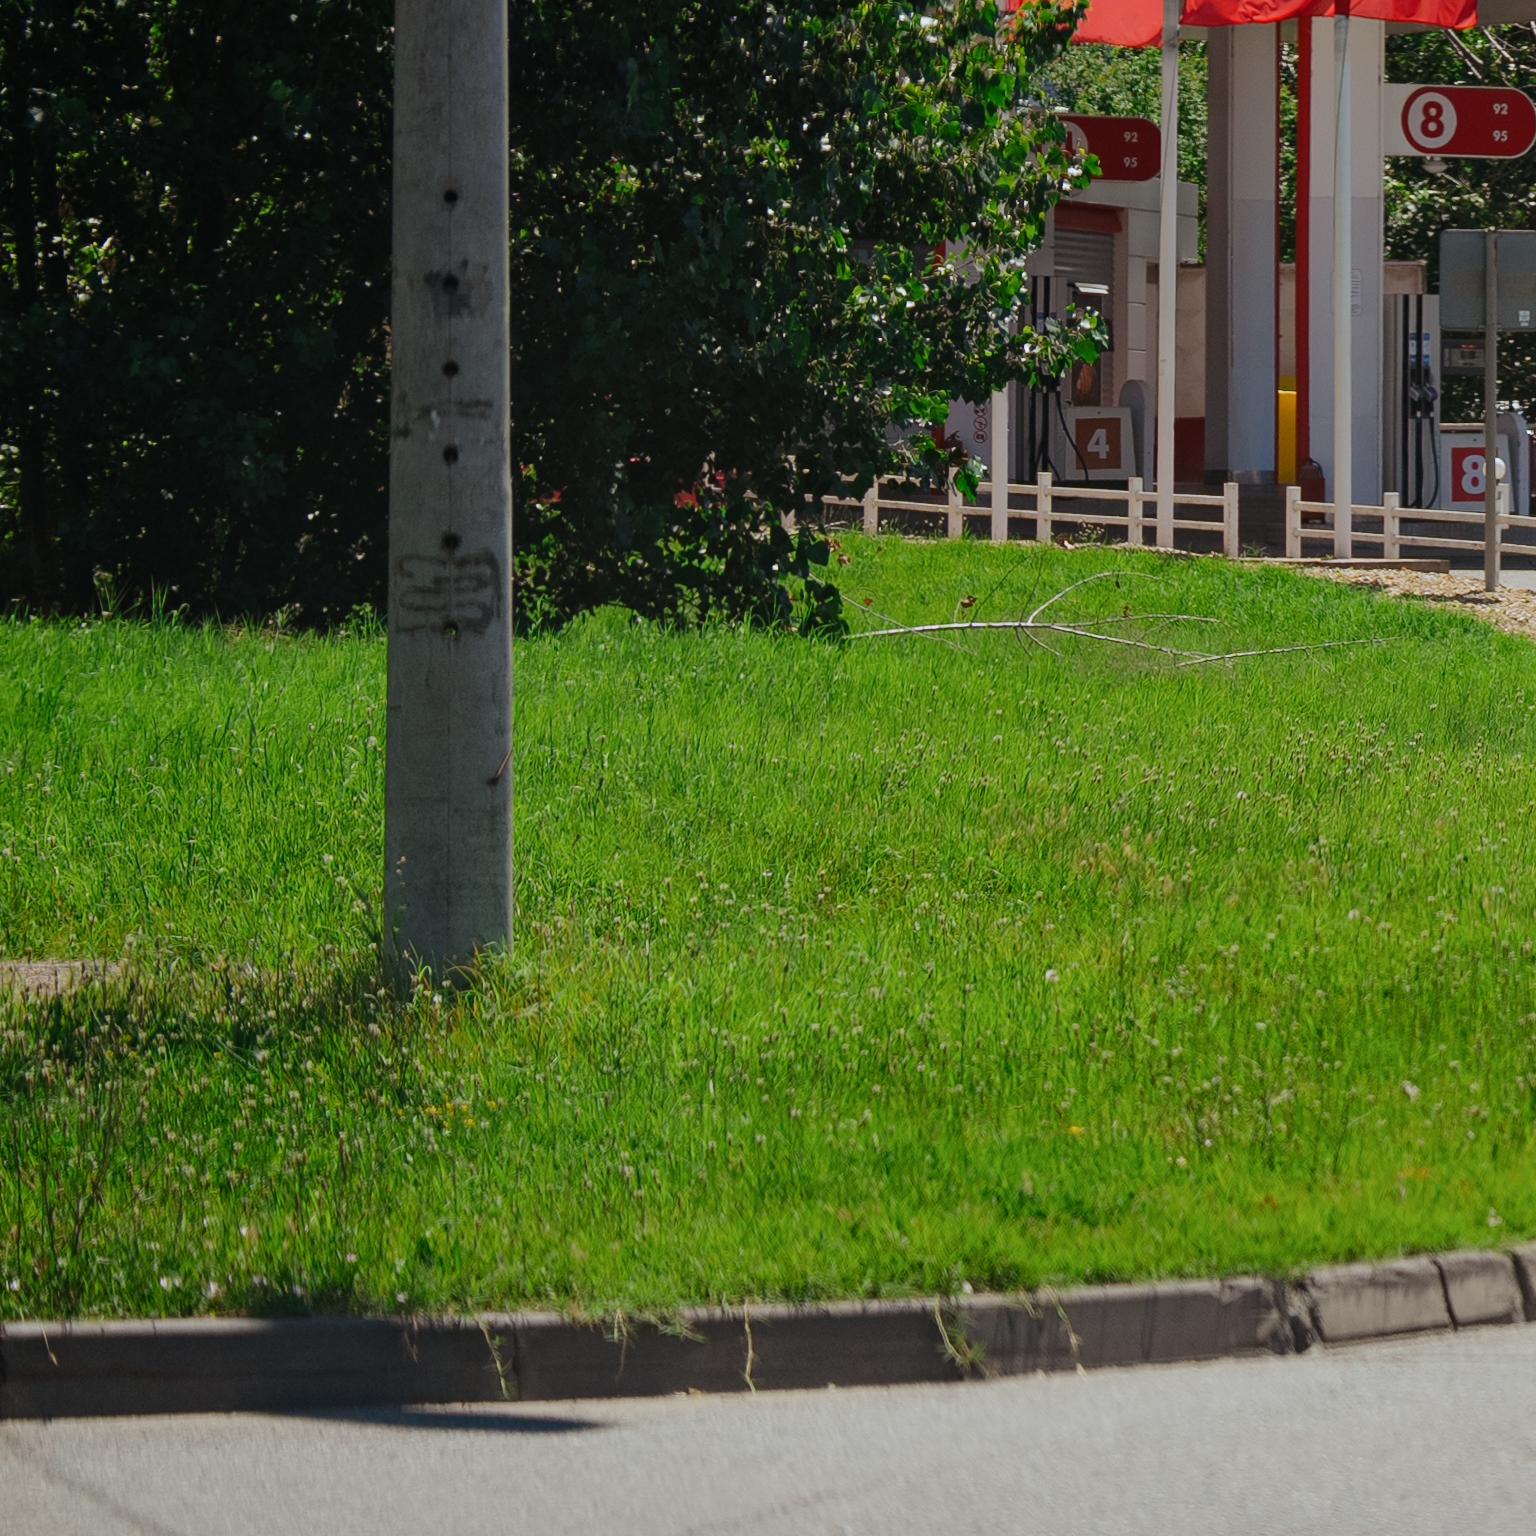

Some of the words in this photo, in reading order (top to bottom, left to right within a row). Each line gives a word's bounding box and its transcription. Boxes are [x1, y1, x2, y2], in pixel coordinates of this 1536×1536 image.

[1493, 103, 1508, 115] 92
[1421, 101, 1445, 138] 8
[1123, 131, 1138, 143] 92
[1493, 130, 1508, 142] 95
[1123, 157, 1138, 168] 95
[1087, 428, 1110, 459] 4
[1461, 455, 1486, 494] 8
